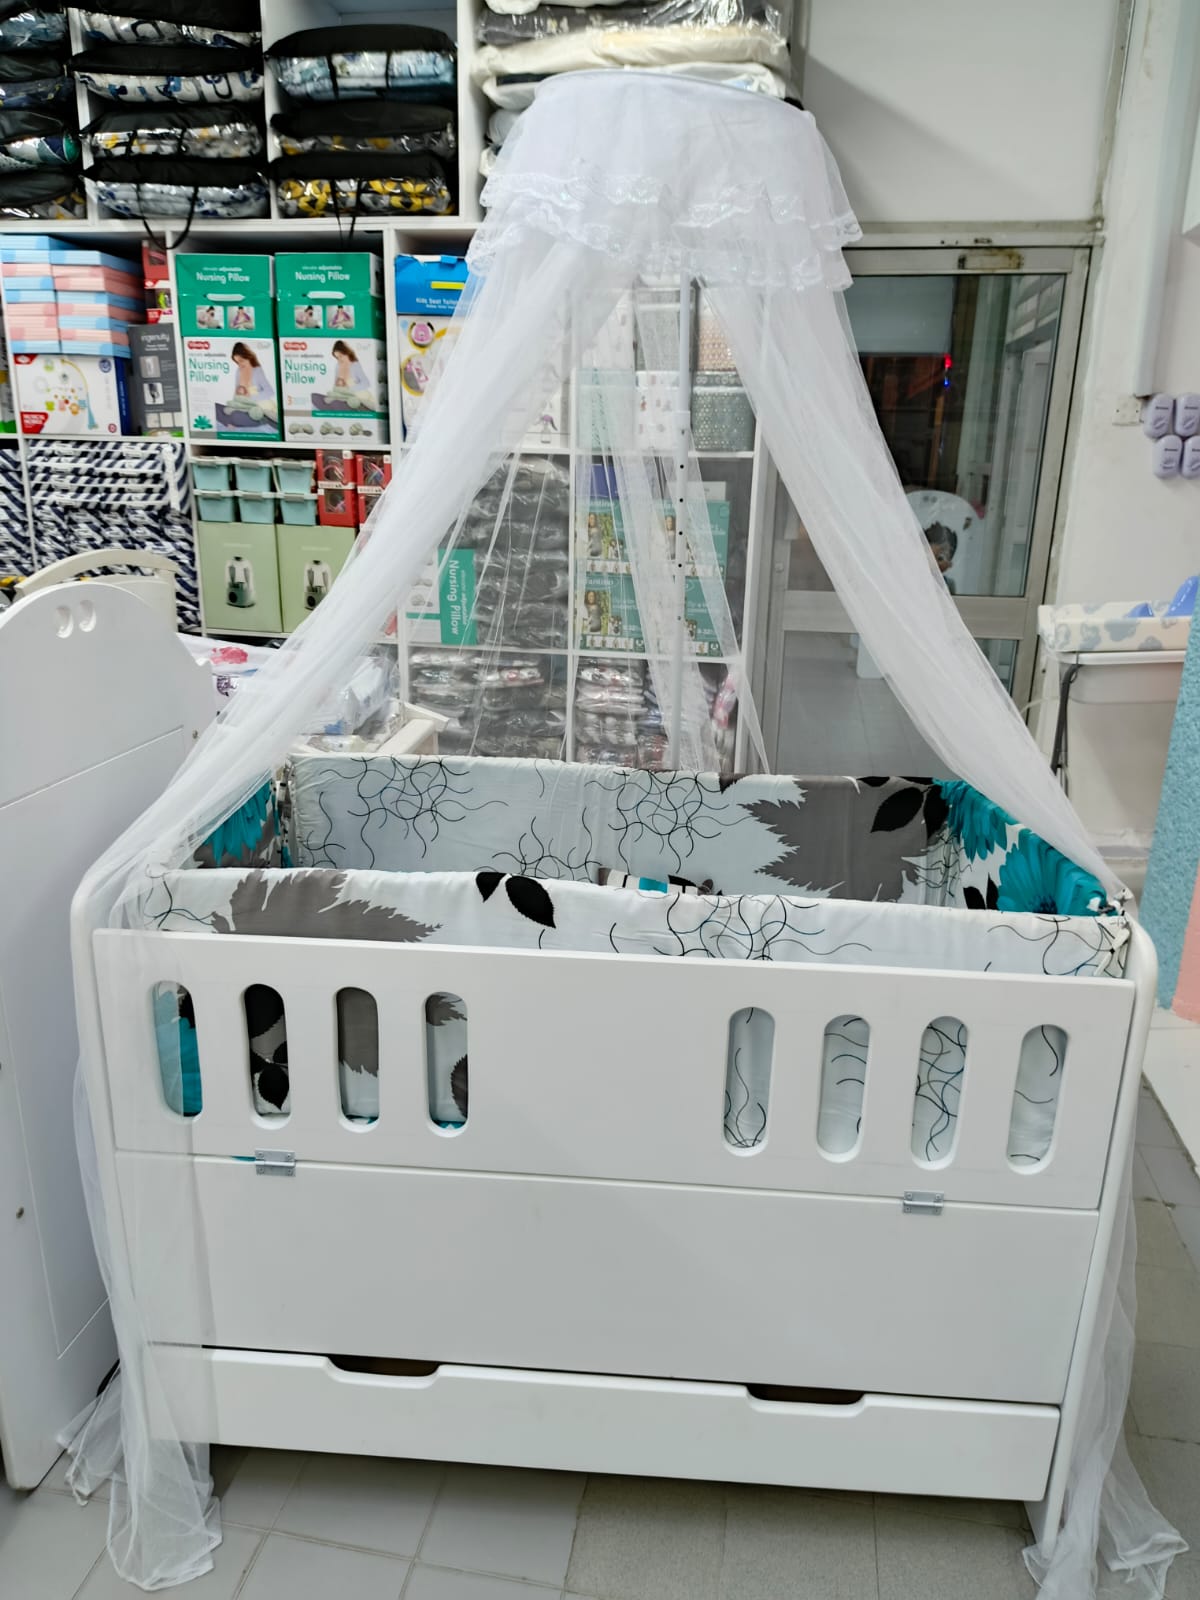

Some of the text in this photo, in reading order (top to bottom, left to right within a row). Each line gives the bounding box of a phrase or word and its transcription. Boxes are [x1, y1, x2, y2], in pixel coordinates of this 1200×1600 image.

[196, 272, 250, 284] Nursing Pillow
[295, 271, 350, 283] Nursing Pillow
[141, 332, 170, 344] ingenuity
[188, 357, 230, 374] Nursing
[284, 359, 327, 375] Nursing
[189, 371, 219, 382] Pillow
[285, 371, 316, 384] Pillow
[446, 560, 461, 635] Nursing Pillow
